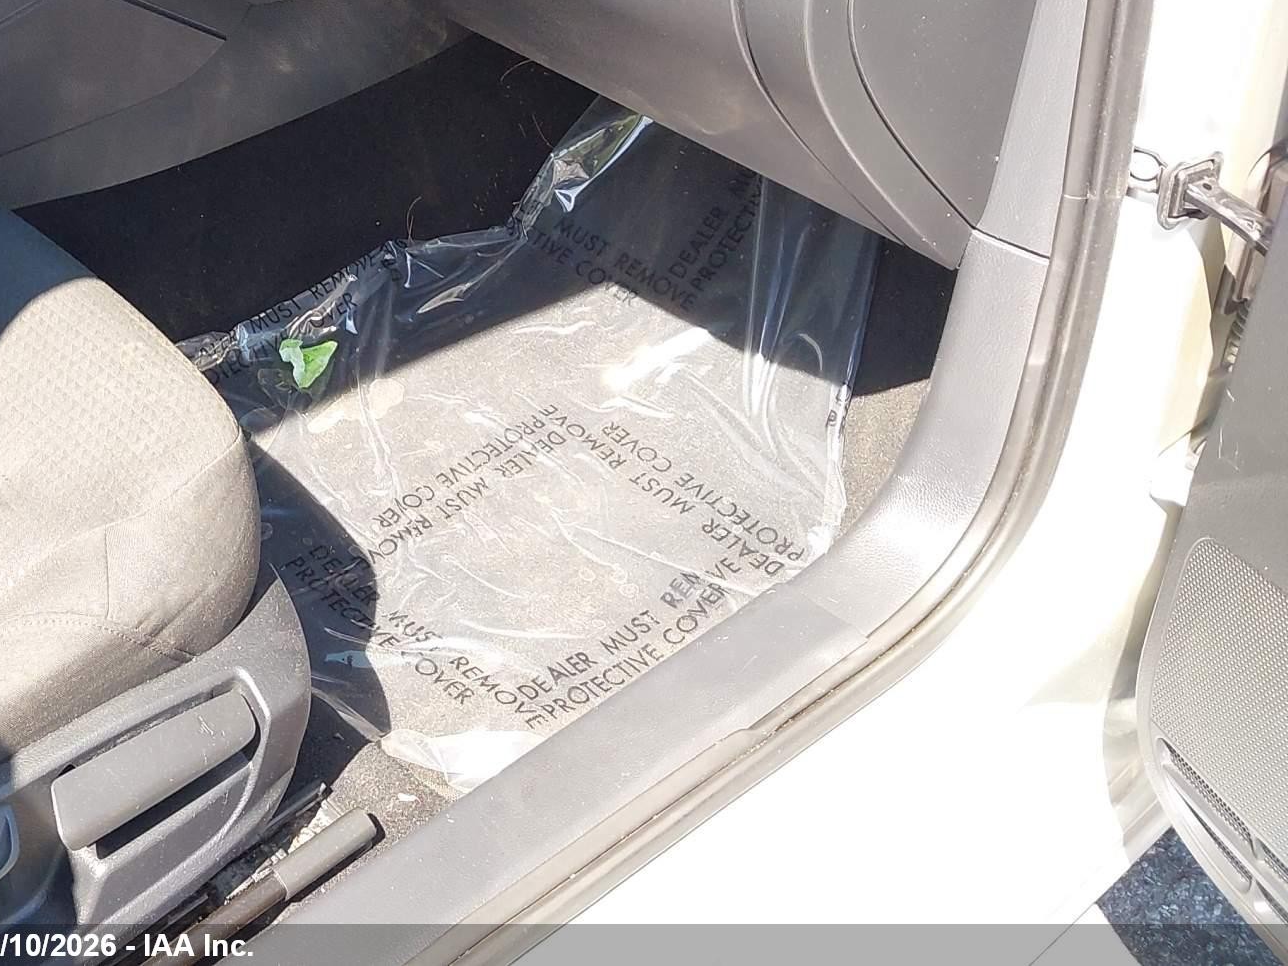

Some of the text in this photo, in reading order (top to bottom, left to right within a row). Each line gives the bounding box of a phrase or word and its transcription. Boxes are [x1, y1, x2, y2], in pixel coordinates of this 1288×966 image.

[553, 216, 698, 313] MUST REMOVE
[669, 206, 728, 279] DEALER
[249, 296, 302, 334] MUST
[372, 414, 546, 528] PROTECTIVE COVER
[435, 476, 489, 520] MUST
[495, 430, 566, 479] DEALER
[537, 404, 786, 576] DEALER MUST REMOVE
[602, 421, 805, 563] PROTECTIVE COVER
[449, 654, 546, 730] REMOVE
[515, 650, 598, 702] DEALER
[589, 608, 661, 656] MUST
[541, 581, 730, 721] PROTECTIVE COVER
